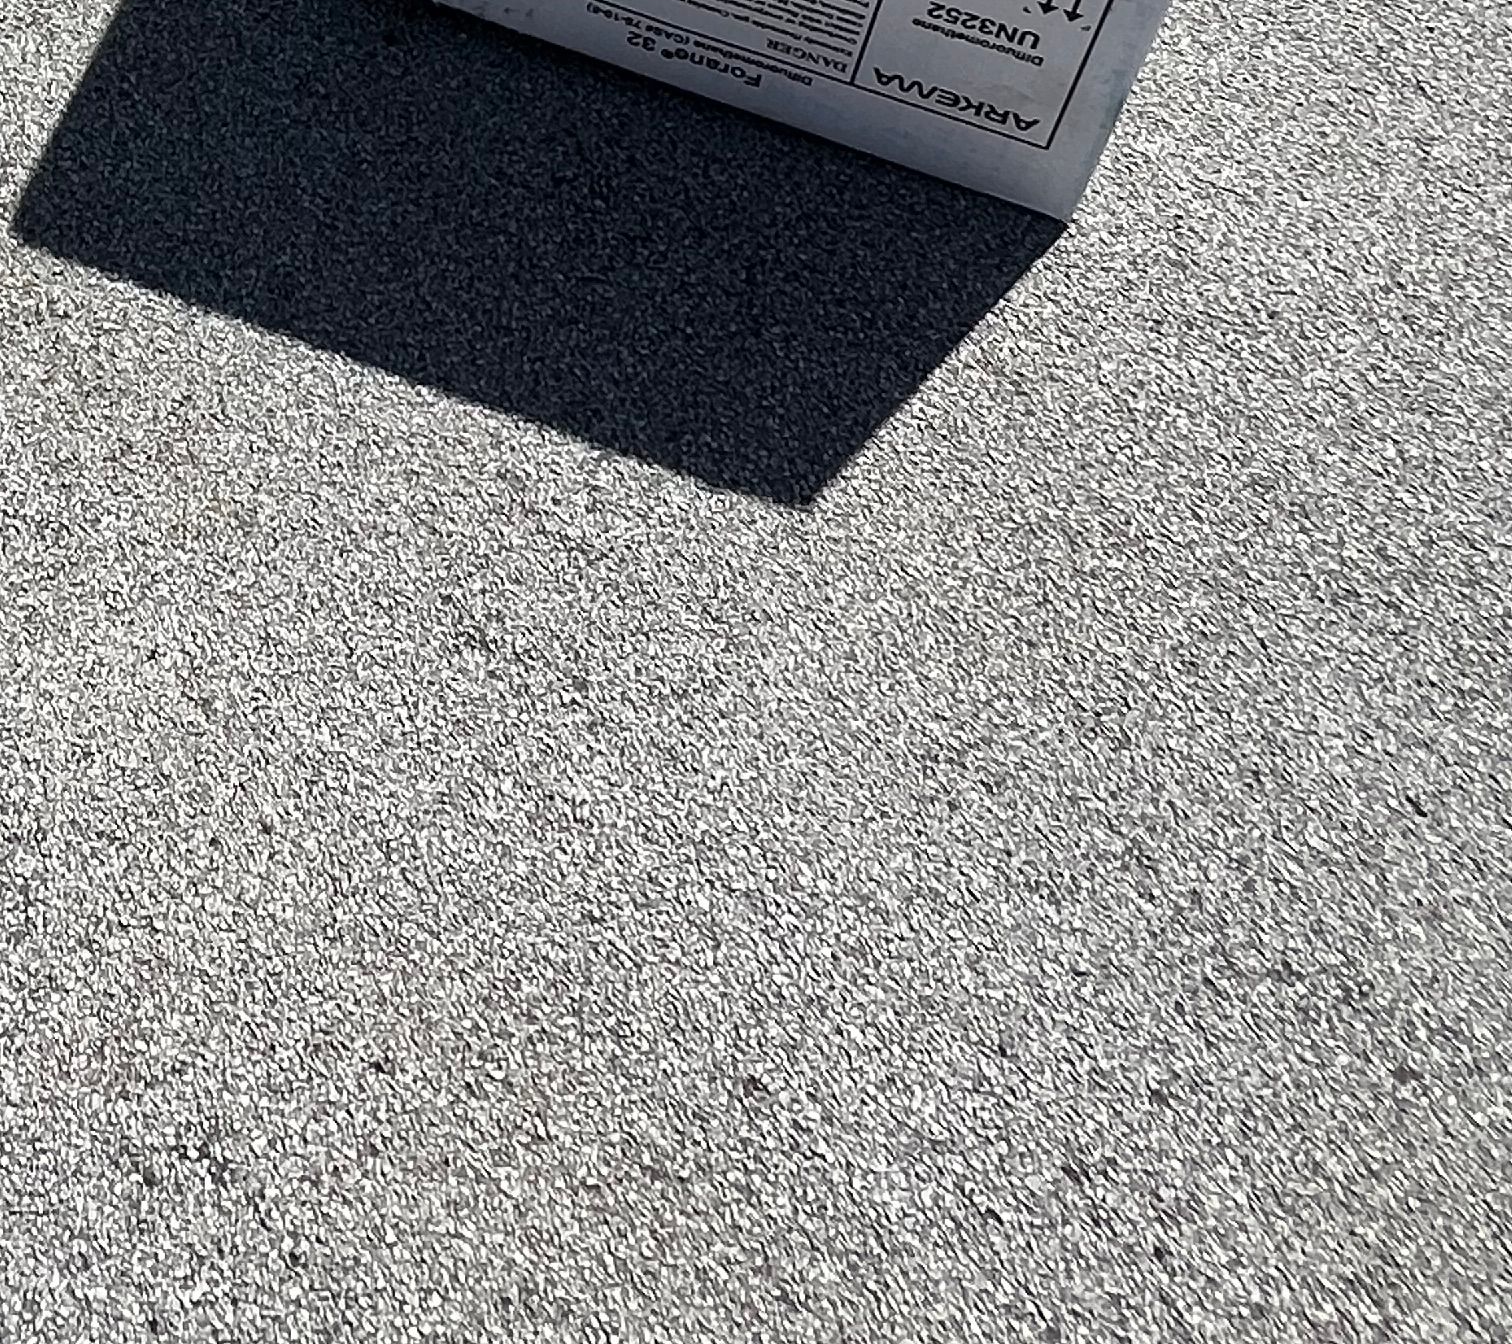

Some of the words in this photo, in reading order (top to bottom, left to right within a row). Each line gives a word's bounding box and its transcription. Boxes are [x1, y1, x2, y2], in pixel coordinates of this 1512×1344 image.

[926, 0, 1040, 50] UN3252
[765, 37, 848, 74] DANGER
[872, 66, 1040, 131] ARKEMA
